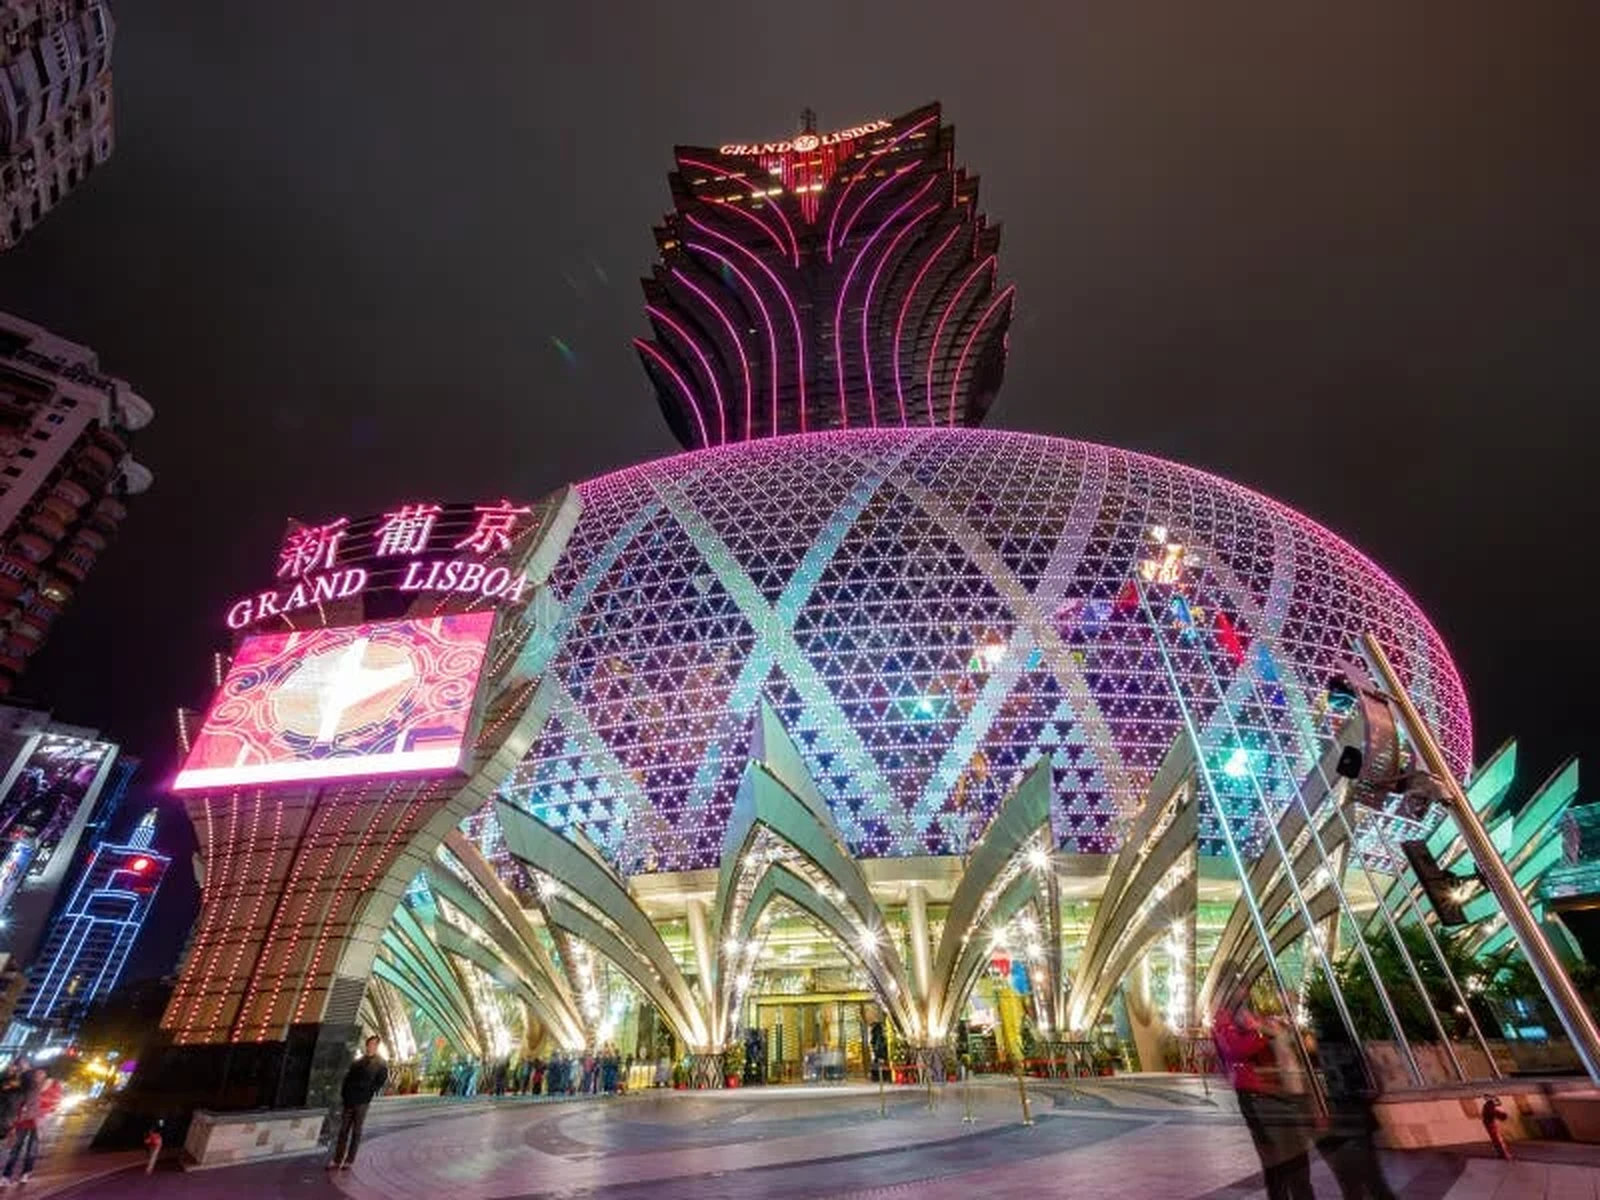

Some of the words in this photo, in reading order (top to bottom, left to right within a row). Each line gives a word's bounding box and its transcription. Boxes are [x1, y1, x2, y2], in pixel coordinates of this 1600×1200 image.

[719, 142, 792, 155] GRAND
[821, 119, 891, 145] LISBOA
[277, 500, 531, 577] 新葡京
[226, 568, 367, 629] GRAND
[400, 561, 530, 602] LISBOA
